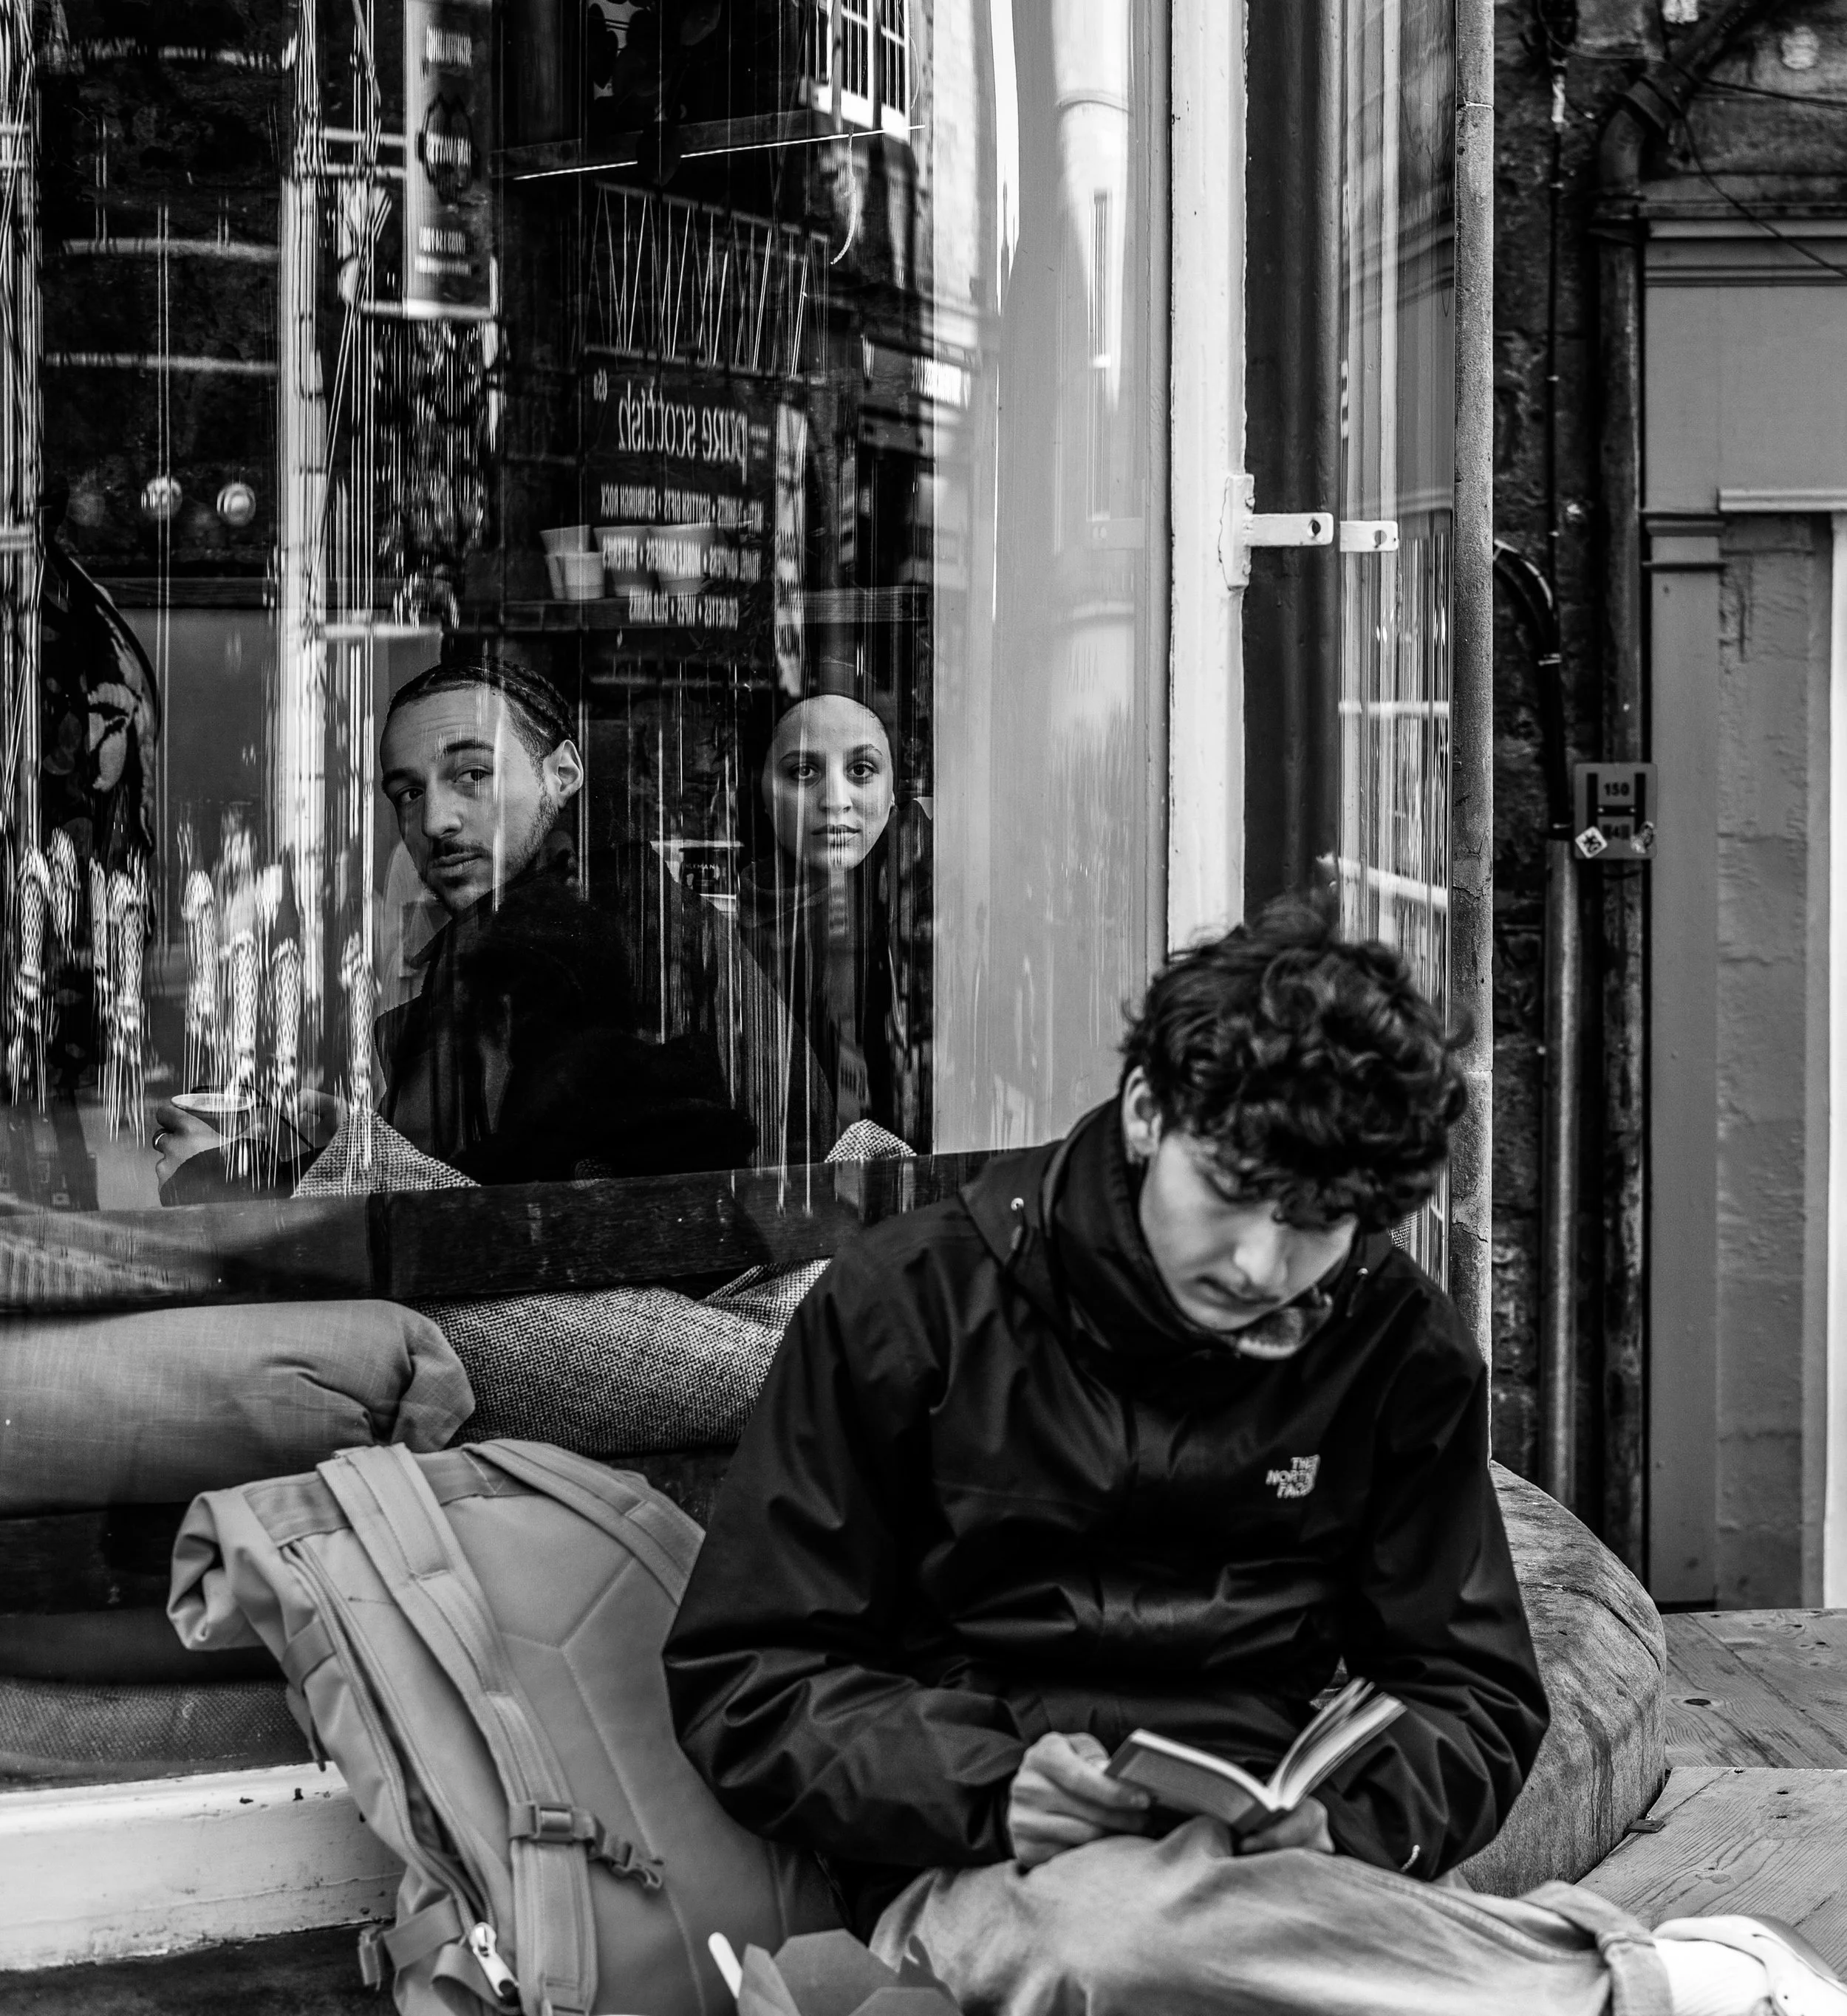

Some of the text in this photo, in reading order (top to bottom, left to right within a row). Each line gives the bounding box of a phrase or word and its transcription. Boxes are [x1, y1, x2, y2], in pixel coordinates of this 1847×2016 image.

[1603, 782, 1630, 796] 150
[1291, 1456, 1314, 1470] THE
[1265, 1469, 1313, 1486] NORTH
[1277, 1482, 1311, 1499] FACE
